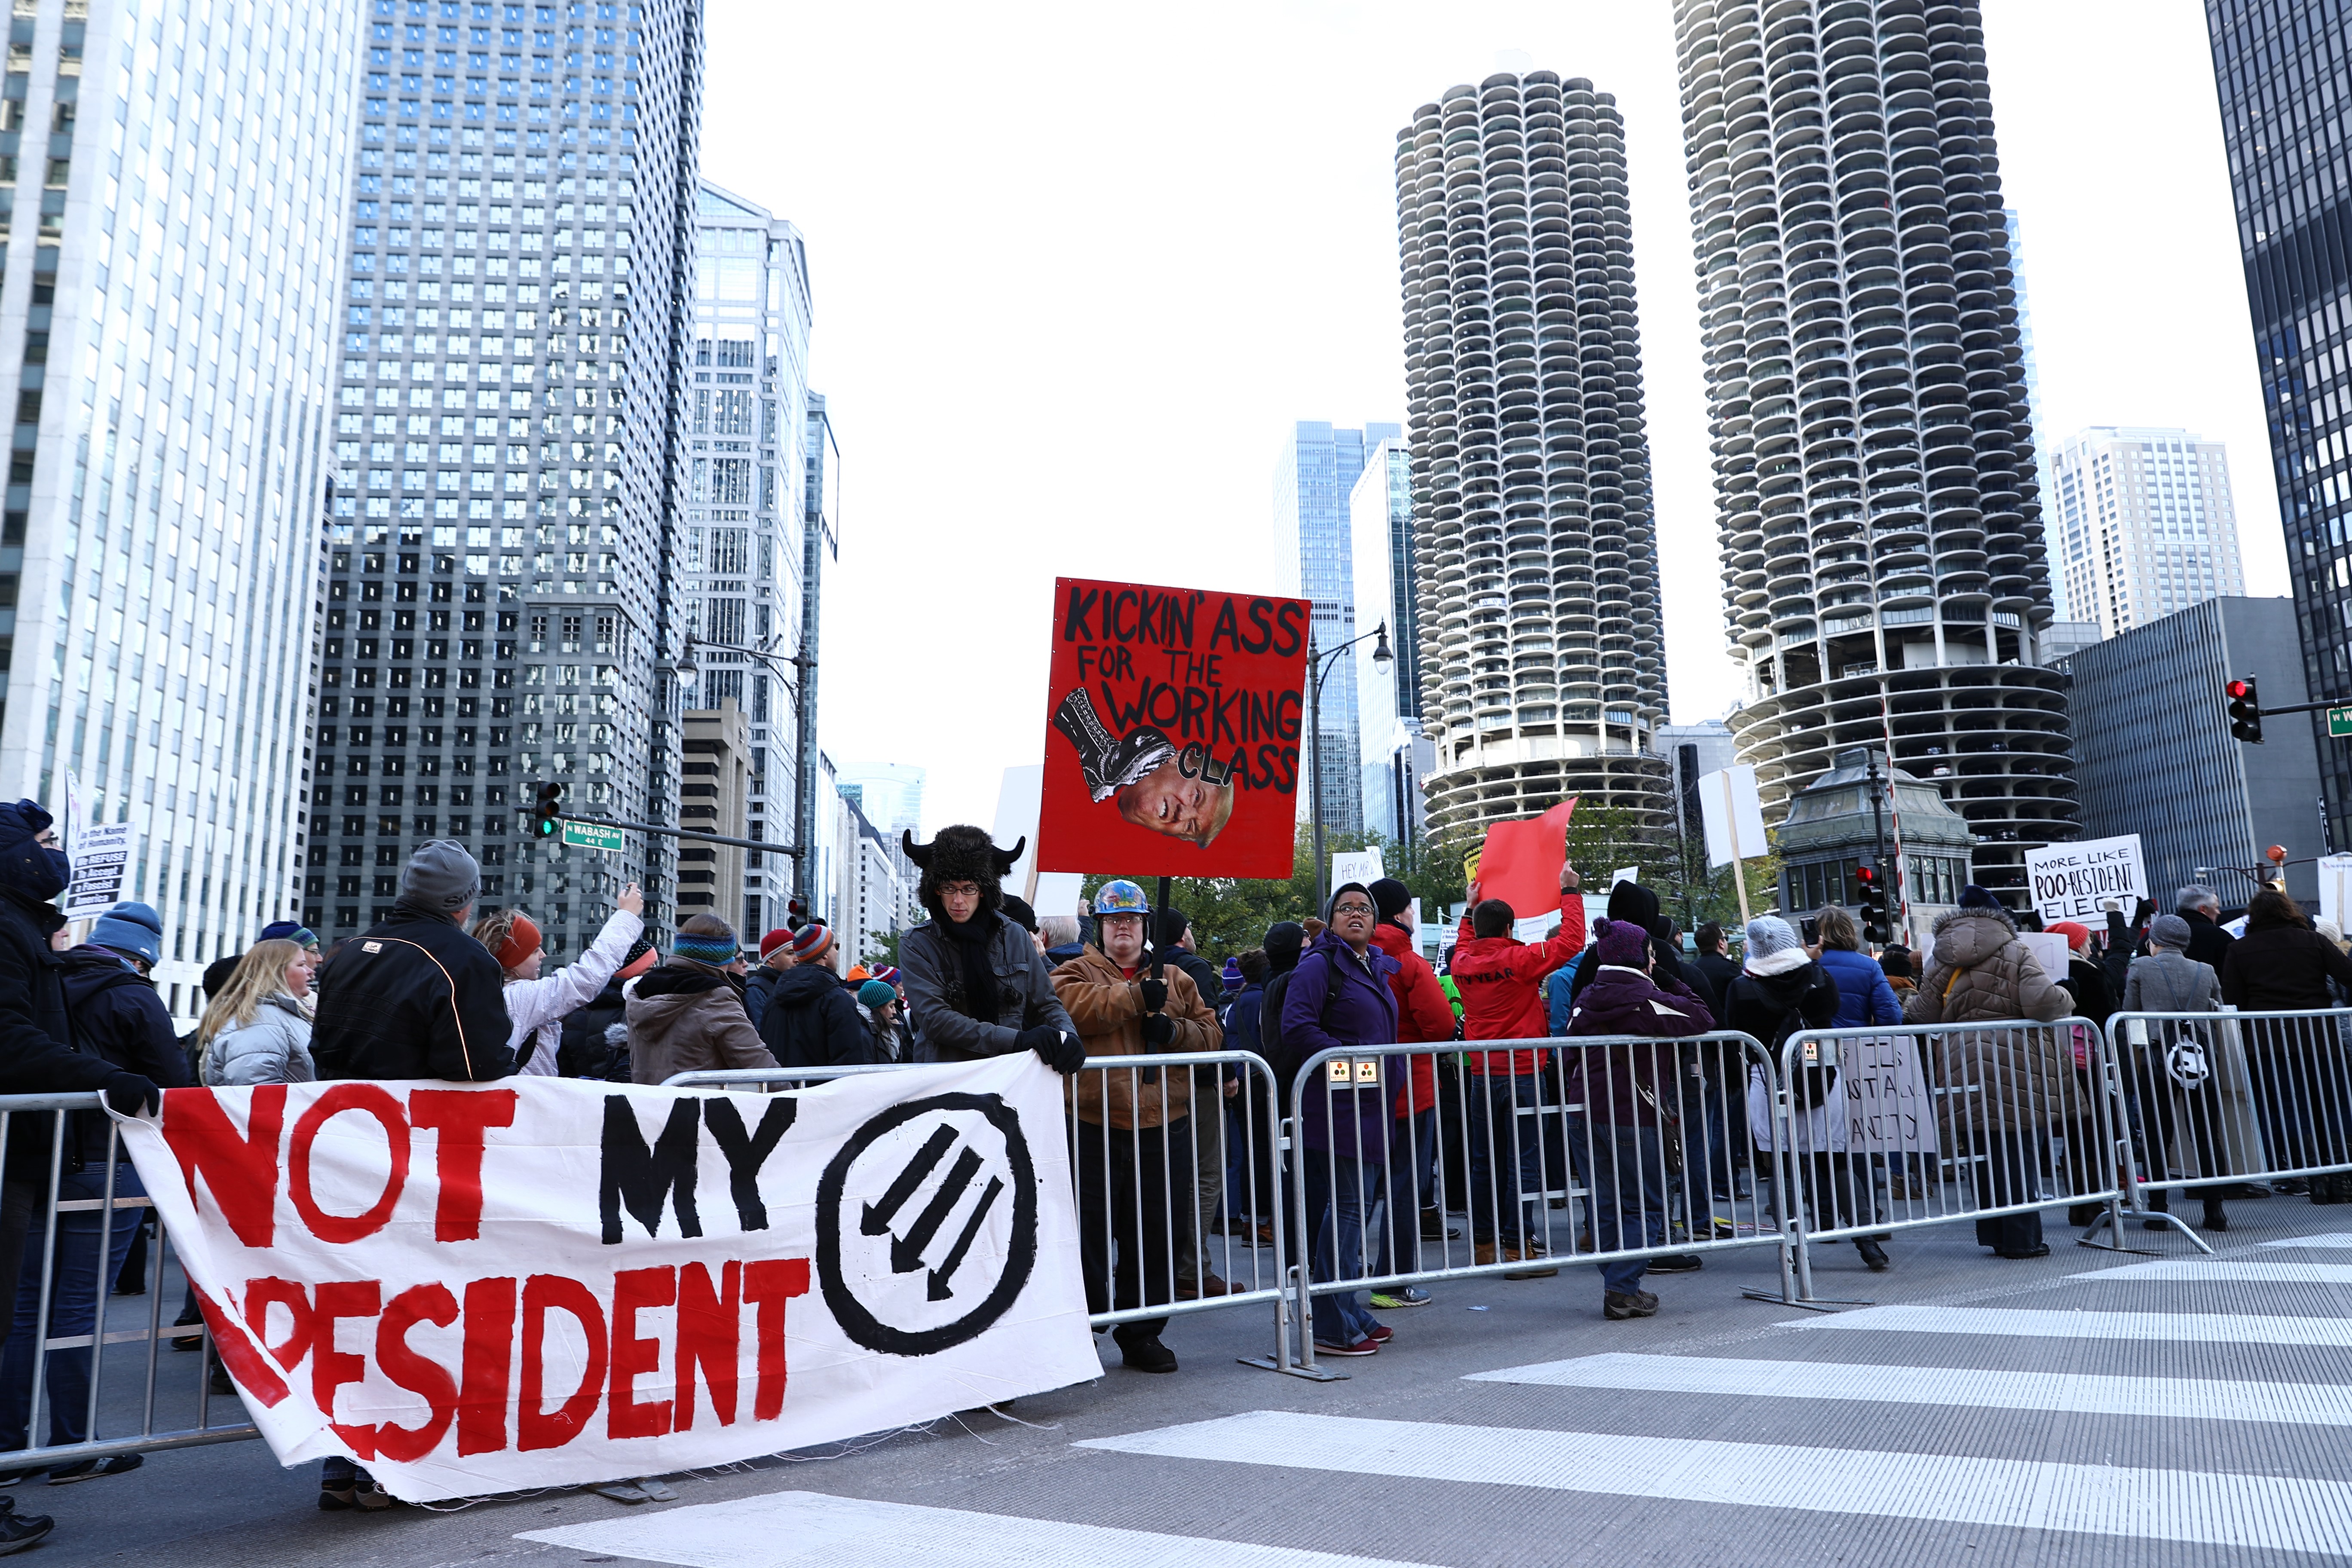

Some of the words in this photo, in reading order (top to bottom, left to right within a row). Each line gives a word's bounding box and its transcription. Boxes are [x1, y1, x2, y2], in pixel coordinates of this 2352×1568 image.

[1064, 587, 1205, 648] KICKIN'
[1210, 597, 1304, 657] ASS
[1078, 646, 1135, 682] FOR
[1163, 649, 1223, 687] THE
[1101, 676, 1302, 746] WORKING
[2332, 714, 2340, 722] W
[1177, 741, 1299, 794] CLASS
[103, 827, 127, 836] Name
[574, 824, 610, 839] WABASH
[89, 852, 126, 864] REFUSE
[2035, 856, 2081, 873] MORE
[2087, 848, 2129, 864] LIKE
[87, 866, 119, 877] Accept
[82, 879, 115, 891] Fascist
[2035, 863, 2133, 901] POO-RESIDENT
[74, 894, 109, 906] America
[1474, 967, 1515, 983] YEAR
[162, 1082, 519, 1249] NOT
[599, 1093, 798, 1245] MY
